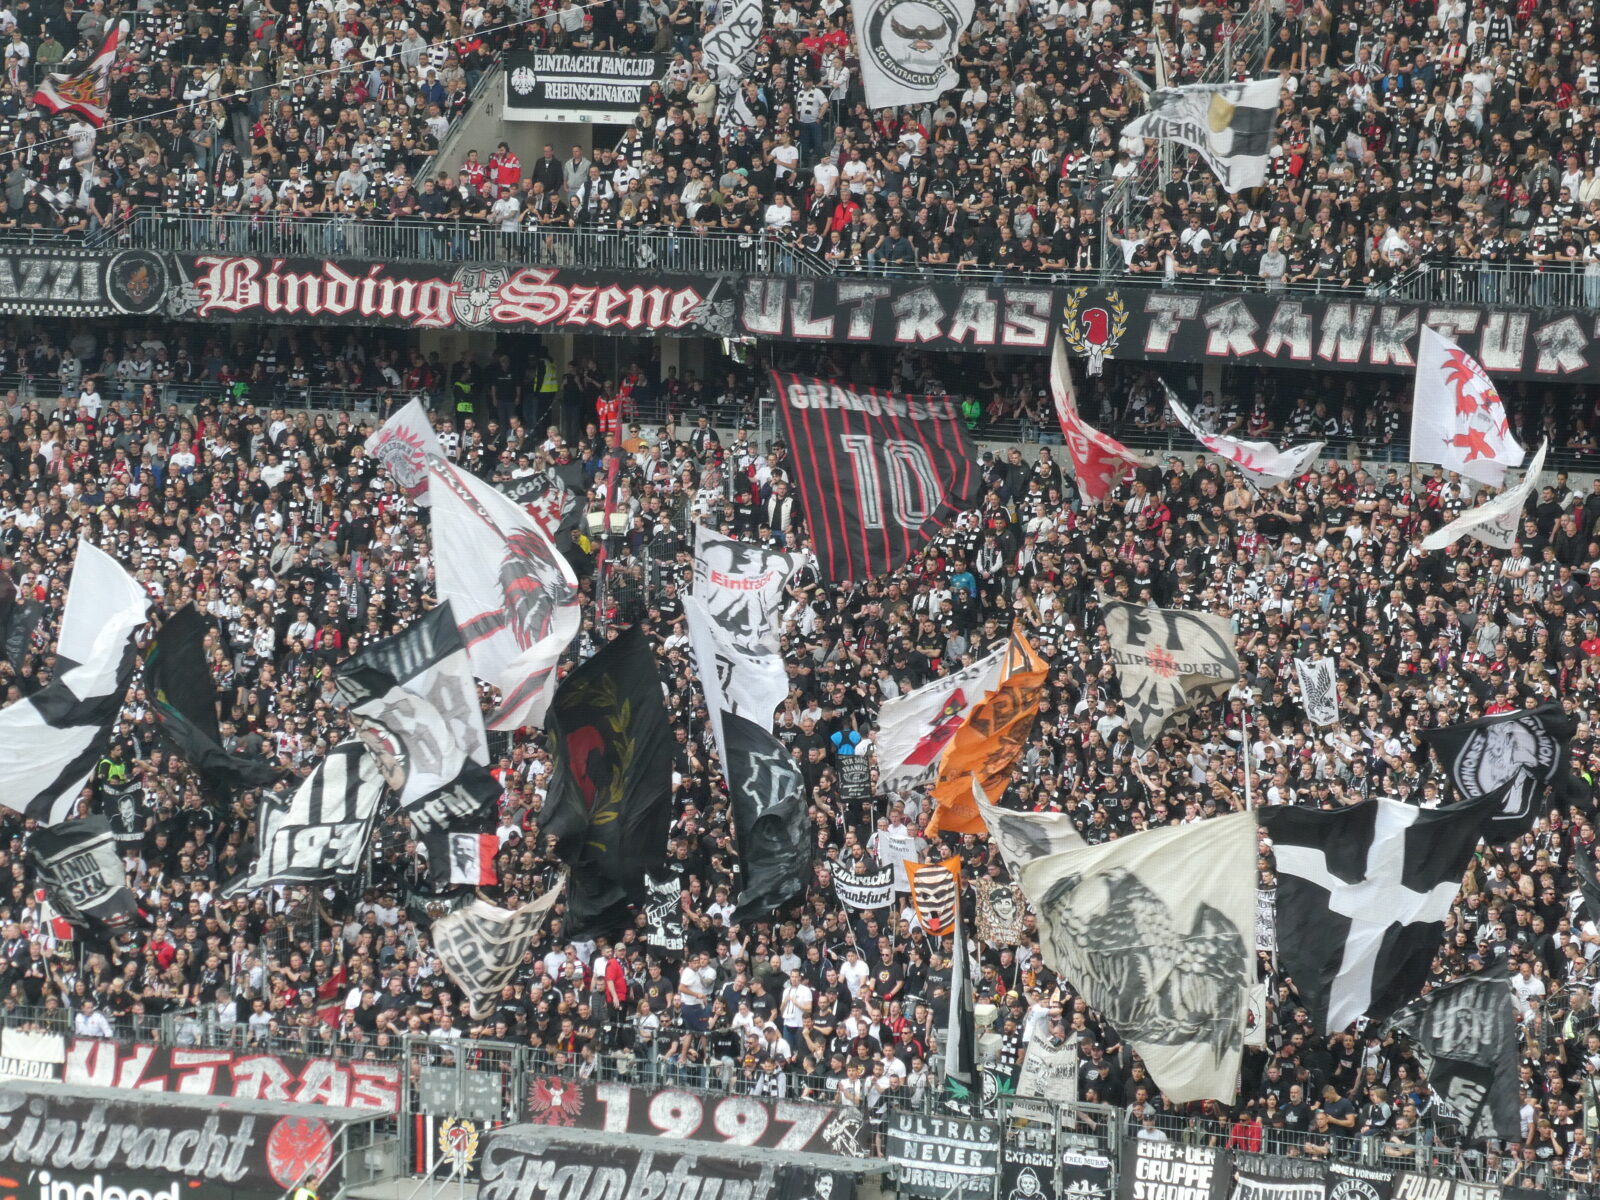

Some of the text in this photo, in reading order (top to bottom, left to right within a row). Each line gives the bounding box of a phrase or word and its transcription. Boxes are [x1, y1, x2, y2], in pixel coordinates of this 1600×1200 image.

[534, 54, 655, 76] EINTRACHT FANCLUB
[884, 58, 930, 83] EINTRACHT
[545, 82, 642, 103] RHEINSCHNAKEN
[195, 255, 706, 329] Binding Szene
[741, 278, 1600, 374] ULTRAS FRANKFUR
[839, 434, 943, 530] 10
[831, 863, 891, 886] Eintracht
[835, 882, 891, 905] Frankfurt
[64, 1038, 400, 1113] ULTRAS
[596, 1083, 834, 1151] 1997
[899, 1115, 991, 1143] ULTRAS
[903, 1142, 982, 1167] NEVER
[1005, 1149, 1053, 1167] EXTREME
[1137, 1142, 1216, 1165] EHRE DER
[1135, 1158, 1214, 1189] GRUPPE
